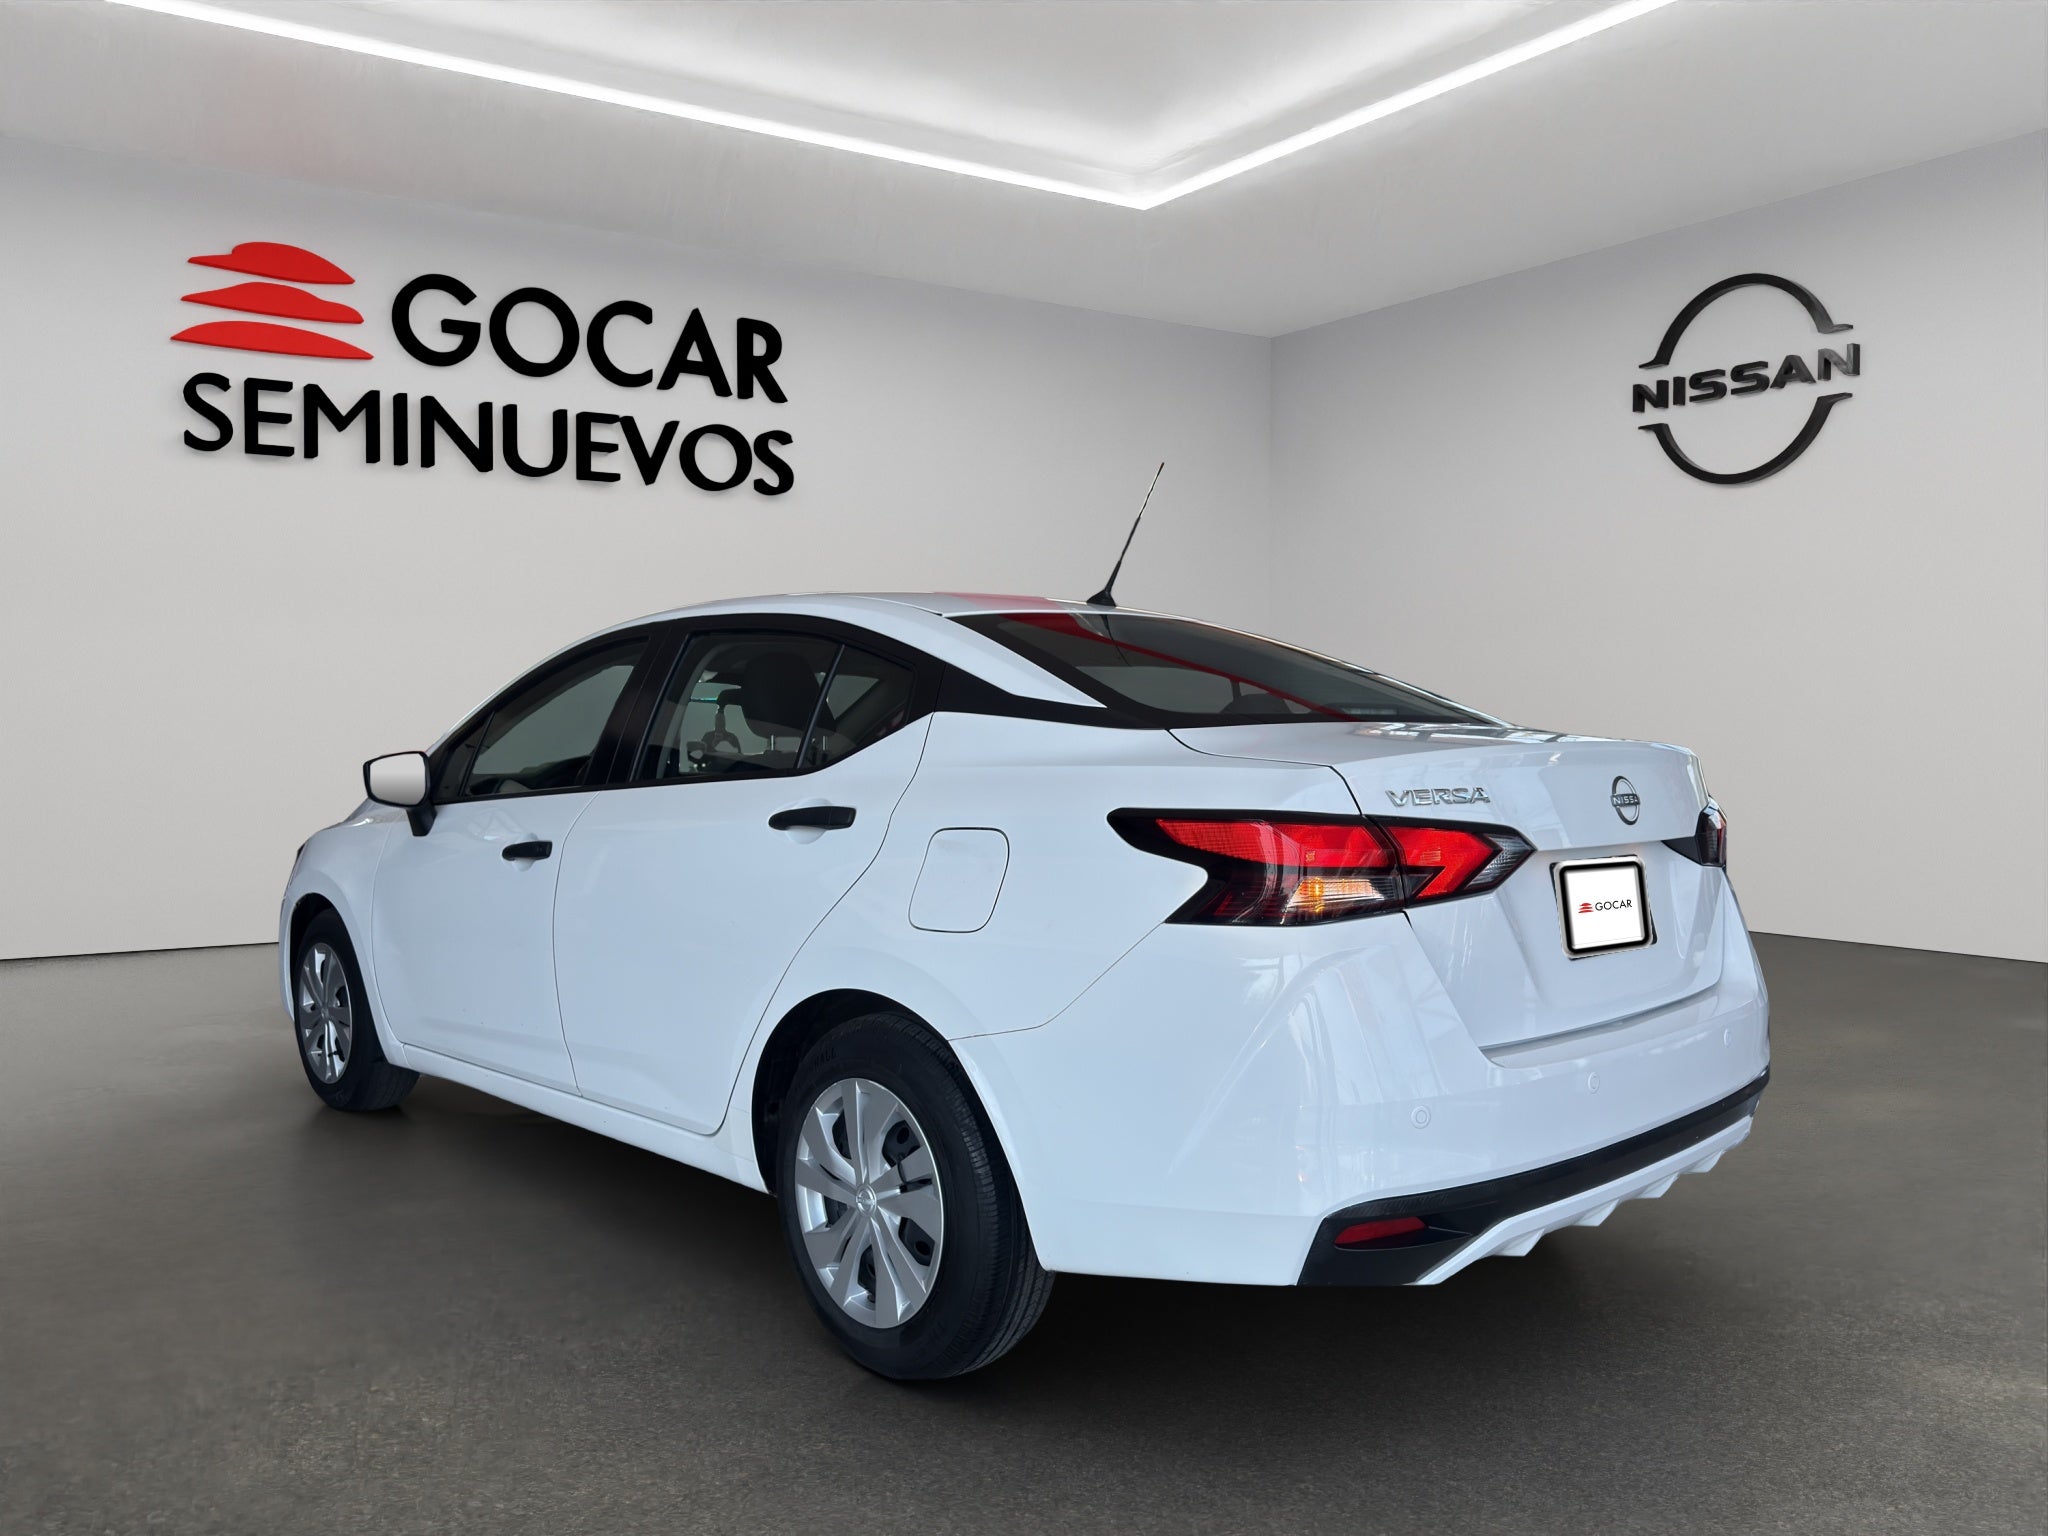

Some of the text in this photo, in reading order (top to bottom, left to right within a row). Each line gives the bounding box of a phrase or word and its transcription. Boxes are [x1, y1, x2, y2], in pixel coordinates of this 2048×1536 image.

[391, 273, 788, 403] GOCAR
[1632, 343, 1861, 413] NISSAN
[182, 372, 795, 496] SEMINUEVOS
[1385, 787, 1491, 807] VERSA
[1613, 795, 1640, 805] NISS
